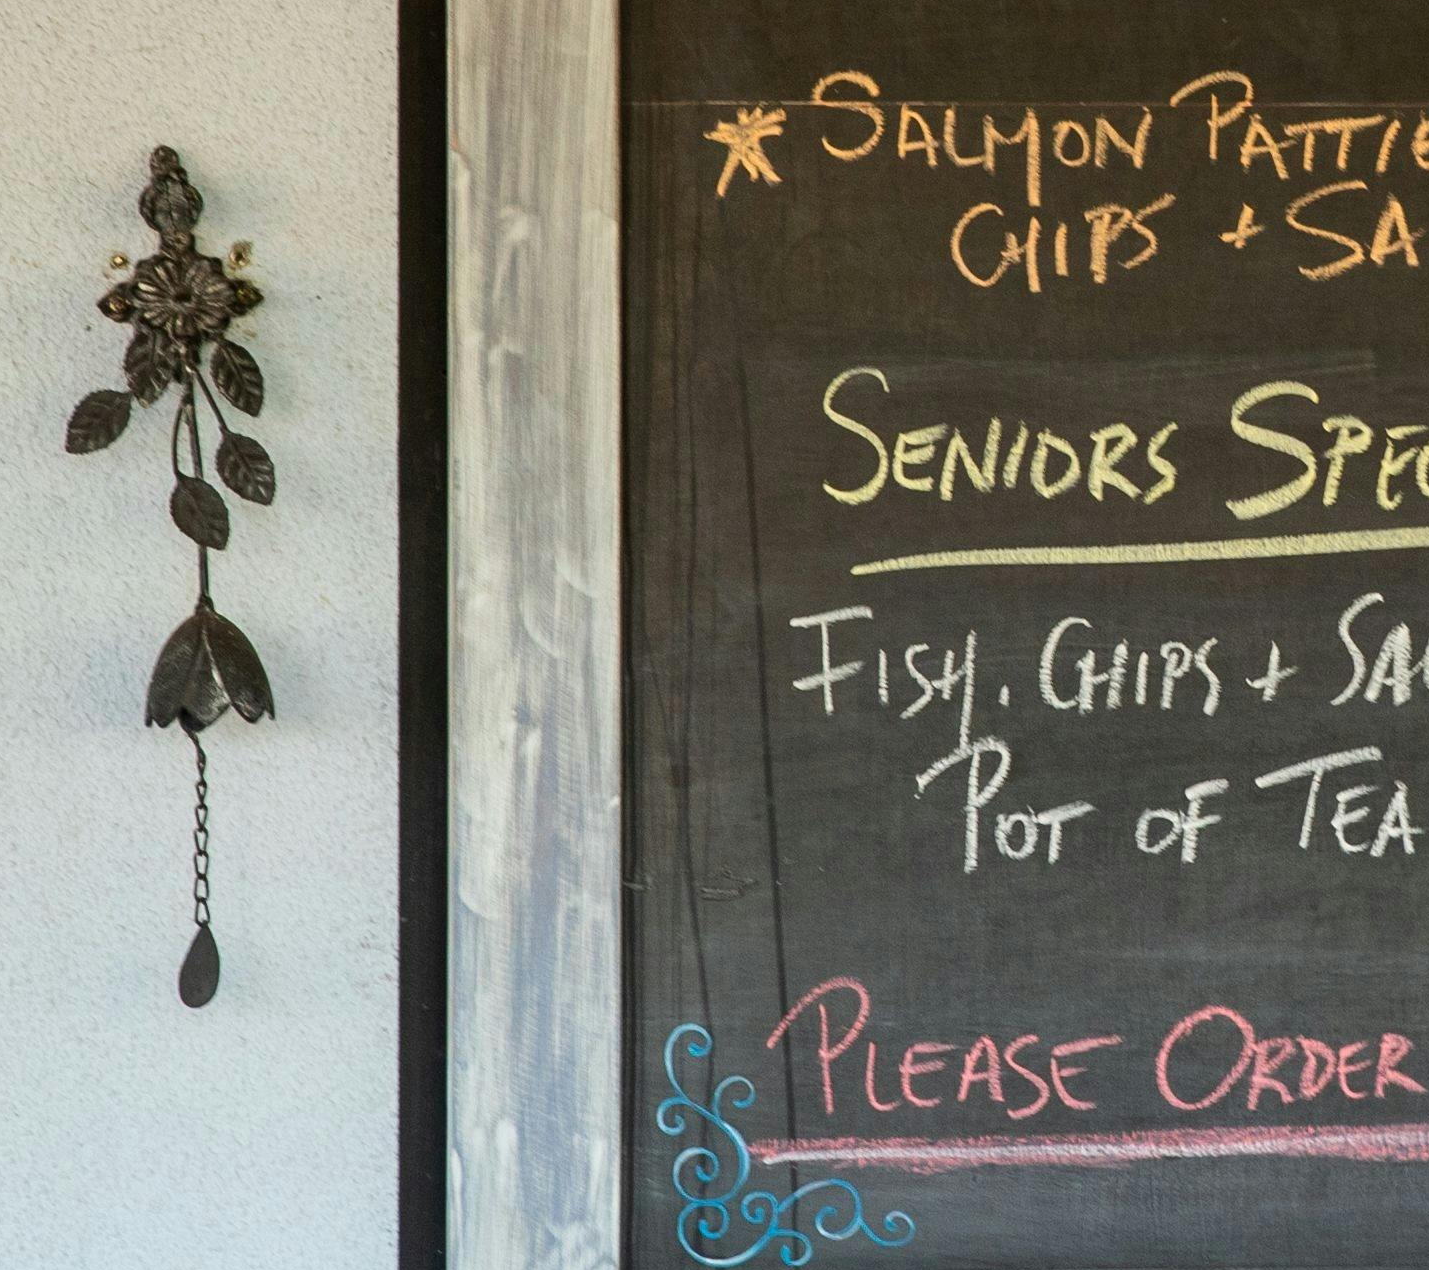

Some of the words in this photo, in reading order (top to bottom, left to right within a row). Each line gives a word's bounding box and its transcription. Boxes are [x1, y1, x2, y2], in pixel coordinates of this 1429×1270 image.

[807, 69, 1156, 207] SALMON
[949, 191, 1178, 295] CHIPS
[1219, 203, 1264, 250] +
[822, 366, 1179, 507] SENIORS
[1038, 616, 1222, 717] CHIPS
[1245, 642, 1298, 703] +
[915, 736, 1094, 874] POT
[1134, 778, 1230, 865] OF
[1254, 745, 1422, 859] TEA
[766, 976, 1122, 1120] PLEASE
[1155, 1004, 1426, 1111] ORDER
